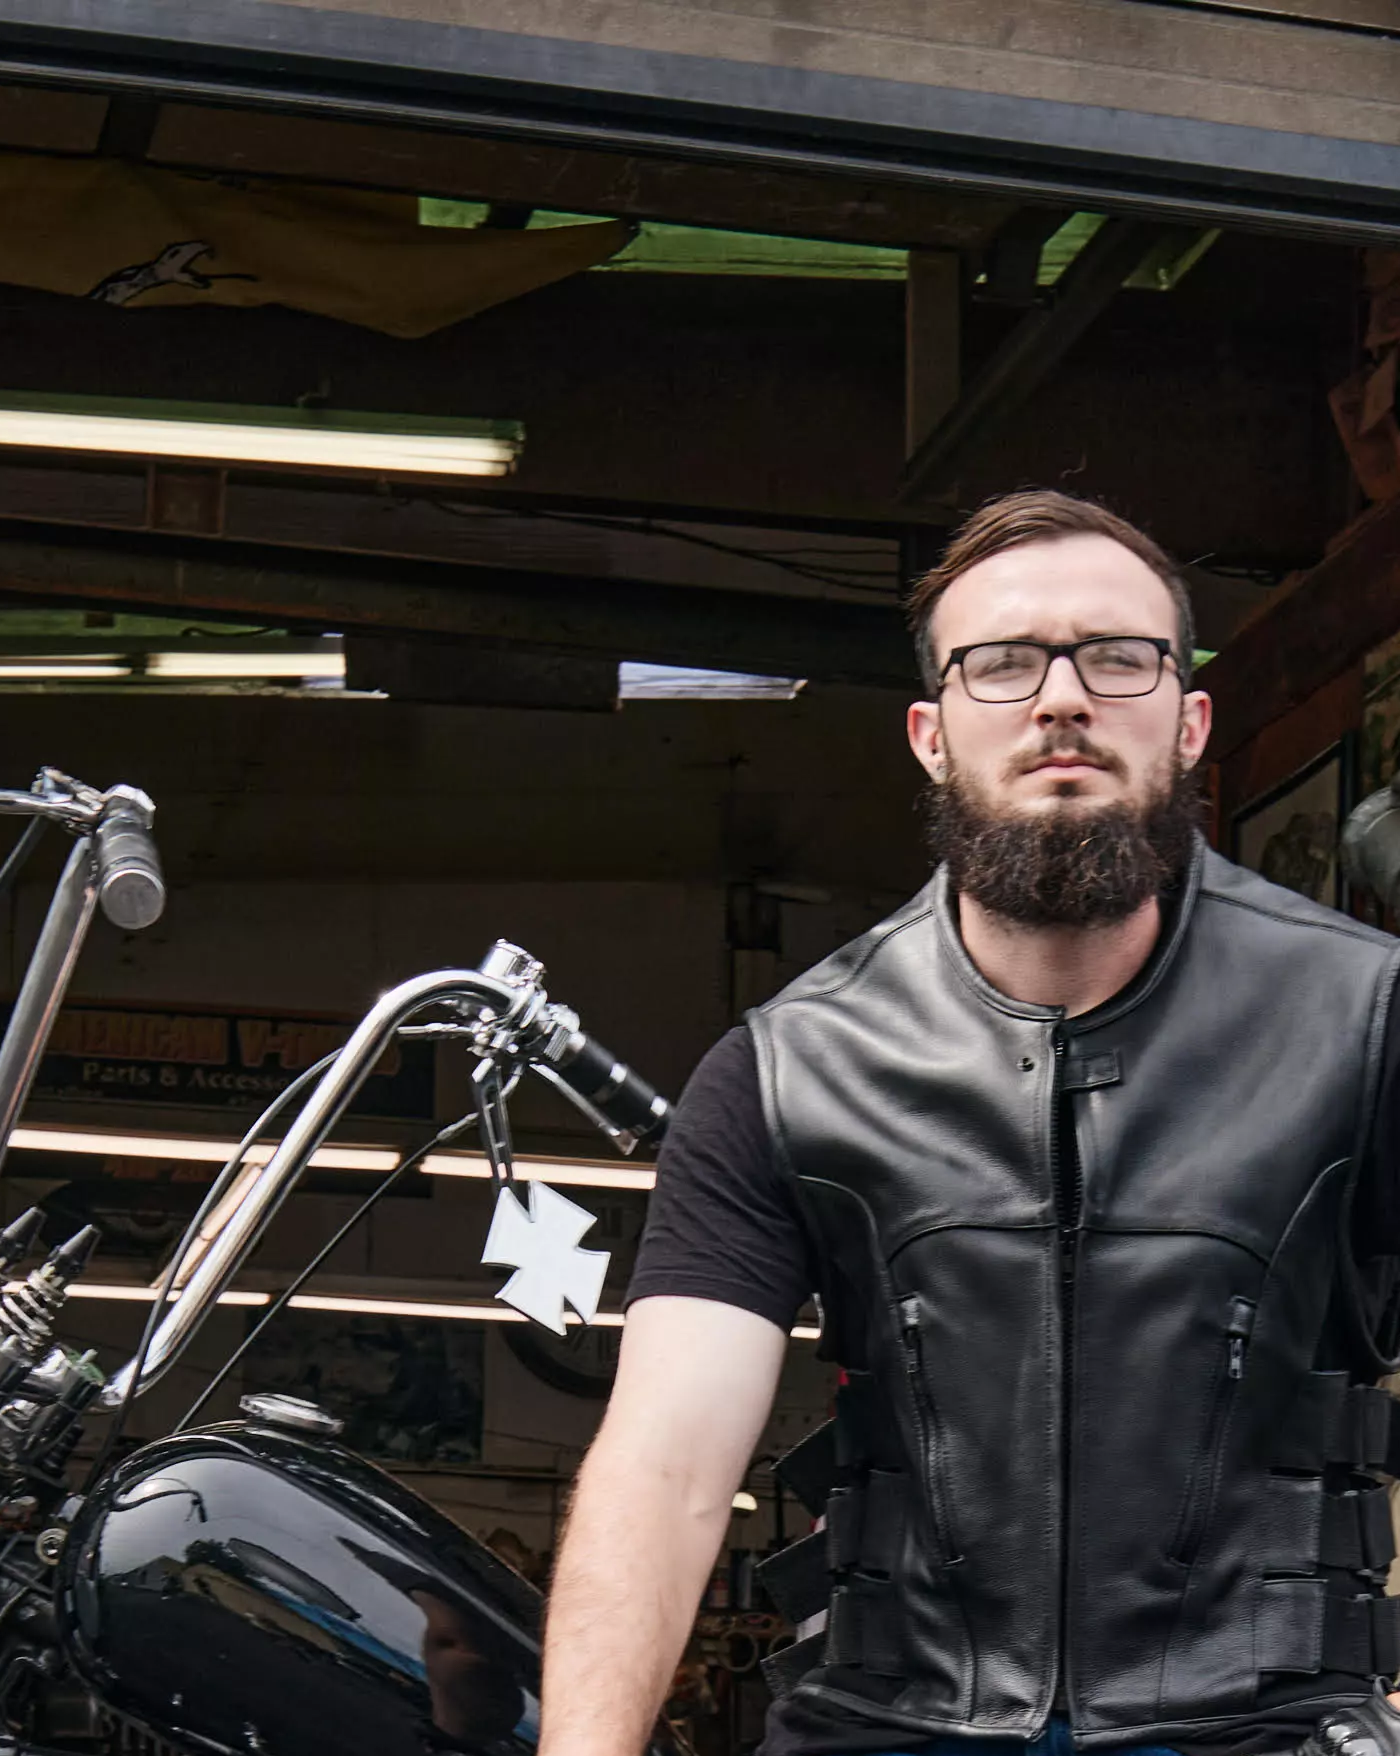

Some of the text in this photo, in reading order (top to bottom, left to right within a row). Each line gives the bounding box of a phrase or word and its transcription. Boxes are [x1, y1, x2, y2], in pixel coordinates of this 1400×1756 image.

[47, 1010, 230, 1065] MERICAN
[82, 1060, 291, 1093] Parts & Accesso
